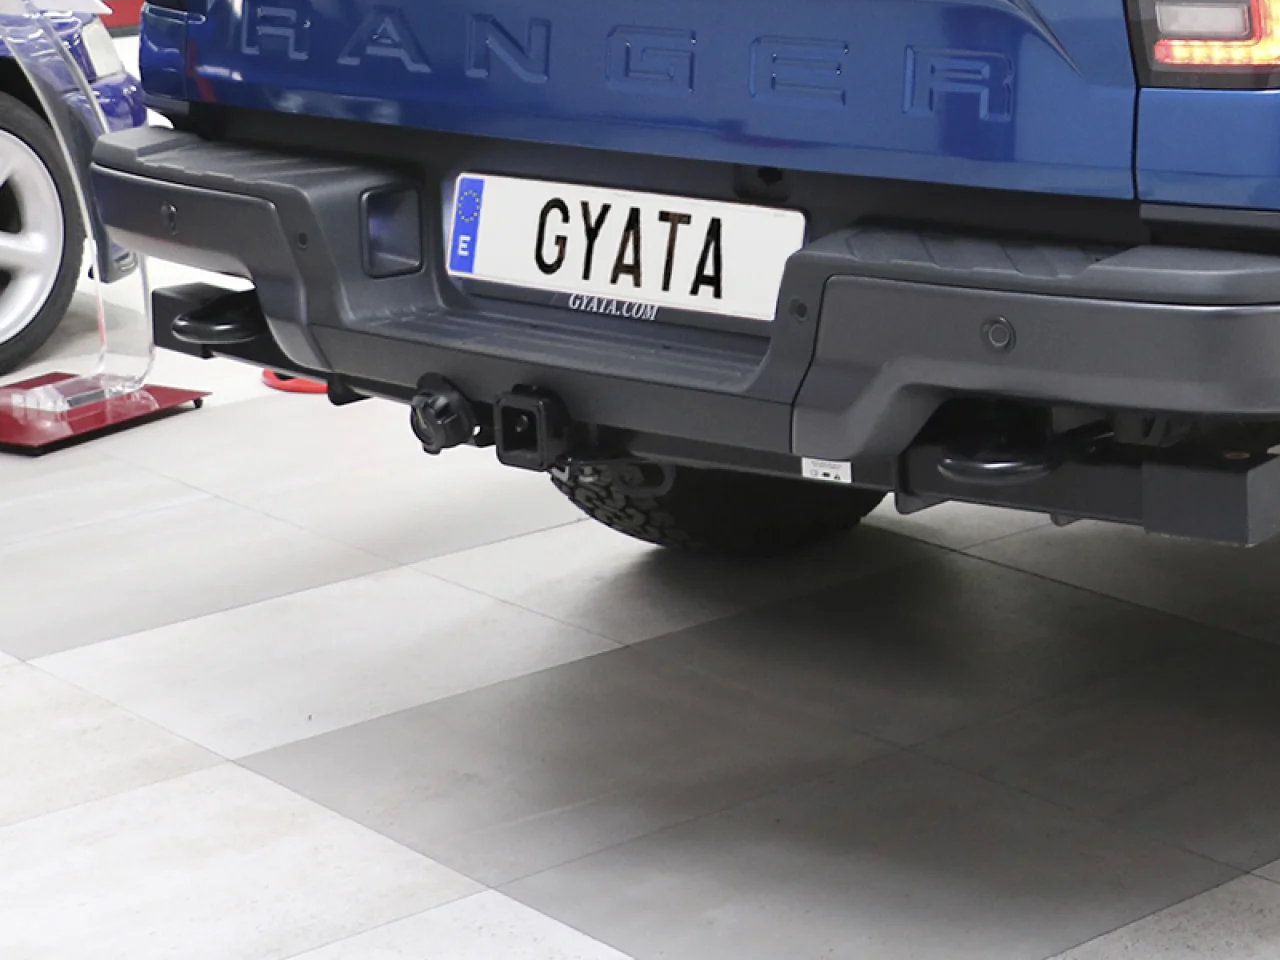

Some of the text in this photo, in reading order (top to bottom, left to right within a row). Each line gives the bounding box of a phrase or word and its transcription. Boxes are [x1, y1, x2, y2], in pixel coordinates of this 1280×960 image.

[240, 5, 1016, 124] RANGER
[456, 197, 723, 300] E GYATA
[568, 293, 659, 320] GYATA.COM
